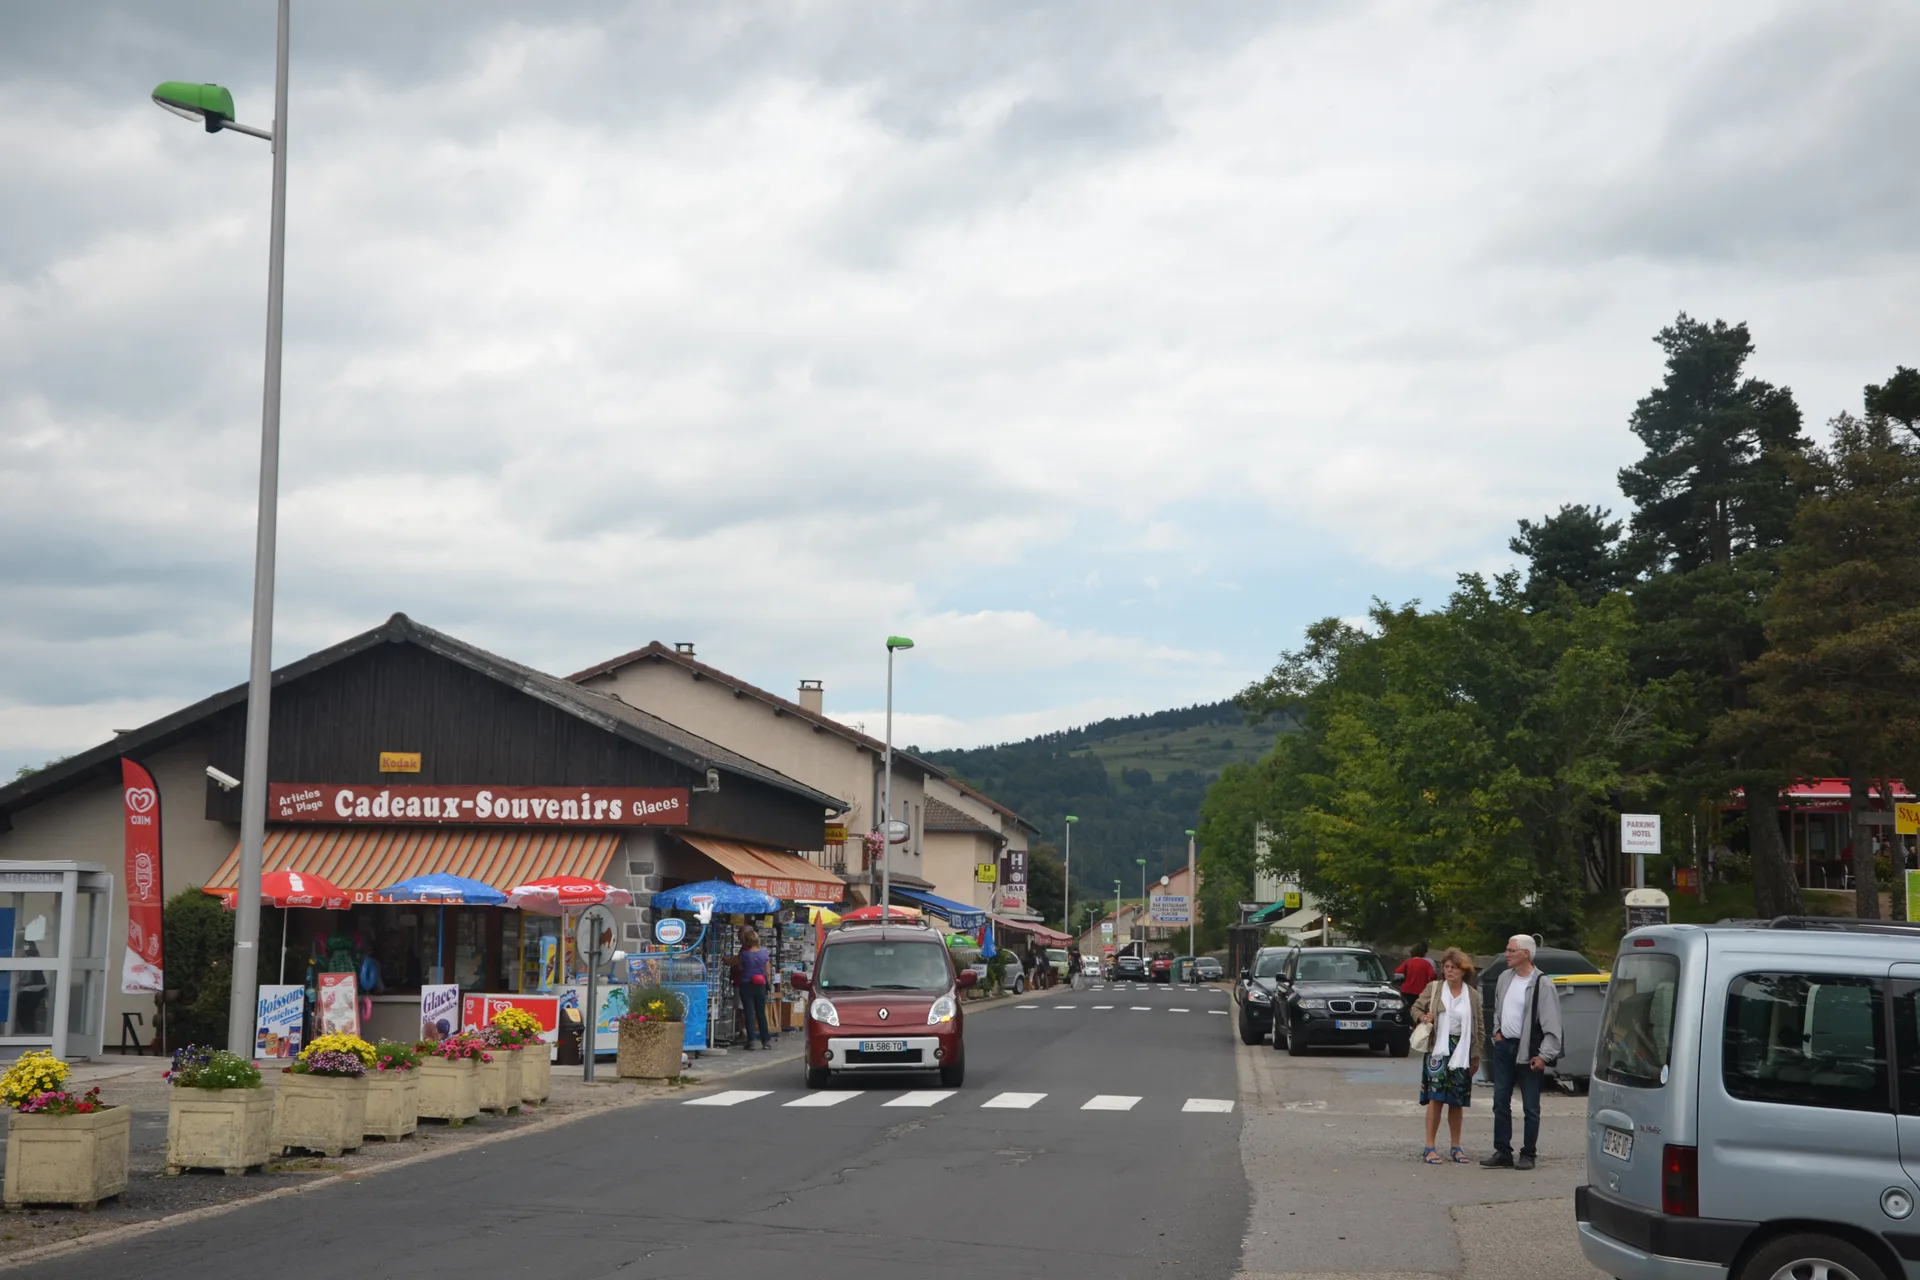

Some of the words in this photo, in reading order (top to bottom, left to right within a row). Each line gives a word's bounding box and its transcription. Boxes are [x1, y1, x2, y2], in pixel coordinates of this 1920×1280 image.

[382, 758, 417, 768] Kodak
[279, 790, 321, 806] Articles
[334, 789, 623, 820] Cadeaux-Souvenirs
[281, 806, 293, 816] de
[296, 801, 323, 813] Plage
[632, 797, 680, 817] Glaces
[1626, 821, 1656, 829] PARKING
[1632, 830, 1652, 838] HOTEL
[260, 988, 304, 1017] Boissons
[424, 986, 457, 1014] Glaces
